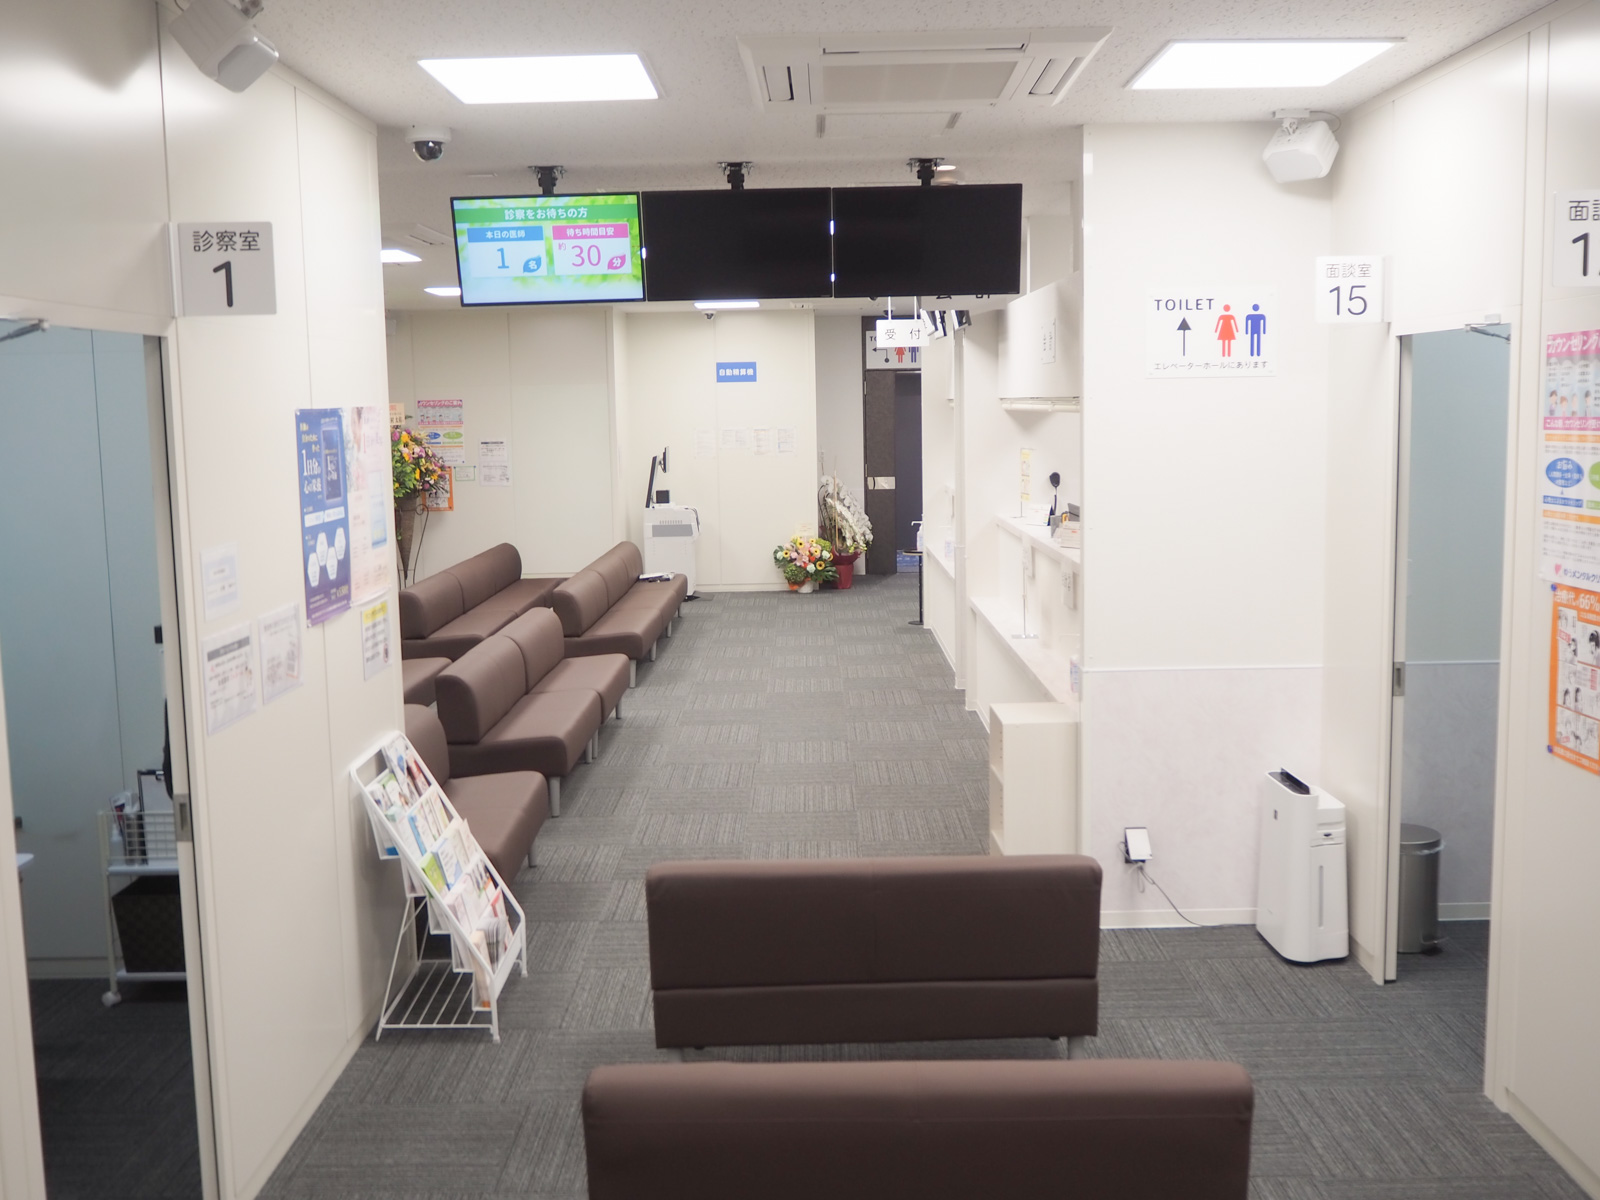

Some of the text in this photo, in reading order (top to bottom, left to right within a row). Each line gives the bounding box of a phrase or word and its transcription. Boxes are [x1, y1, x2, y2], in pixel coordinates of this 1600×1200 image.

[504, 207, 588, 221] 診察をお待ちの方
[485, 229, 526, 239] 本日の医師
[566, 227, 615, 238] 待ち時間目安
[192, 230, 261, 252] 診察室
[497, 247, 538, 270] 1 名
[558, 242, 622, 267] 約 30 分
[1326, 263, 1371, 278] 面談室
[212, 260, 233, 308] 1
[1154, 298, 1215, 311] TOILET
[1329, 285, 1368, 316] 15
[719, 368, 754, 377] 自動精算機
[1154, 361, 1268, 370] エレベーターホールにあります
